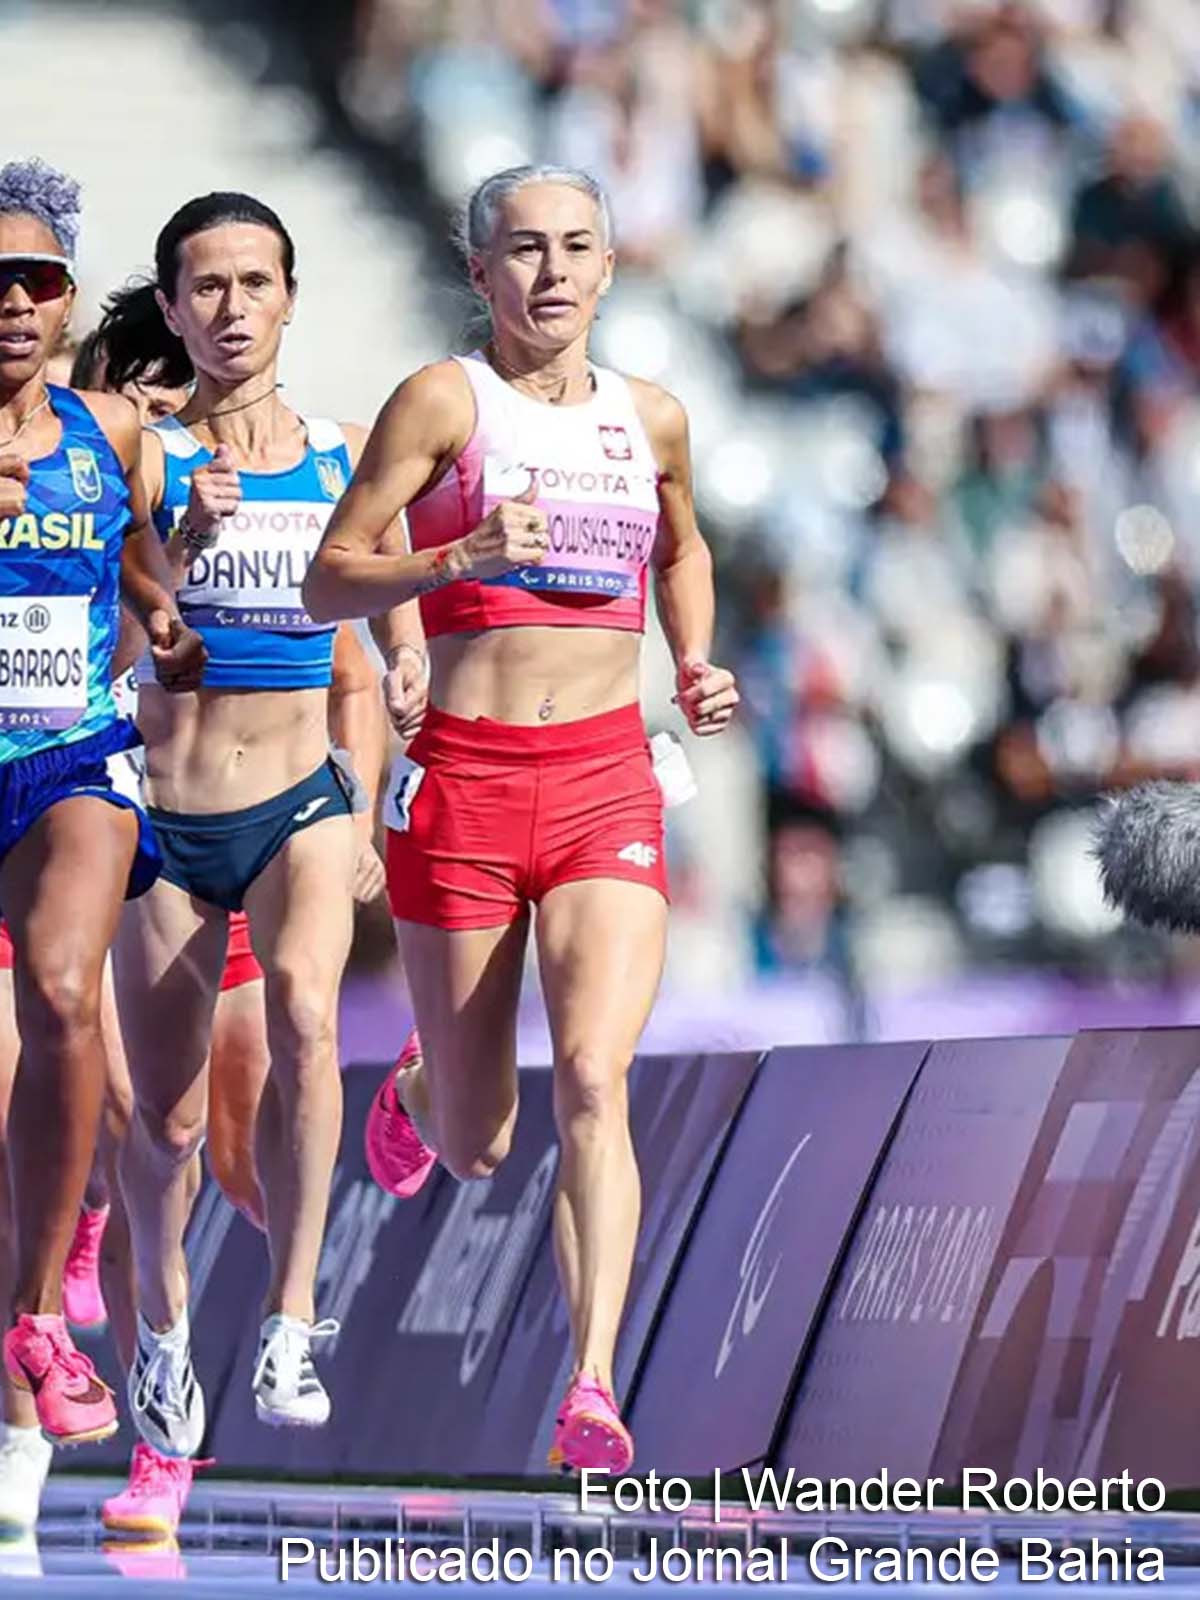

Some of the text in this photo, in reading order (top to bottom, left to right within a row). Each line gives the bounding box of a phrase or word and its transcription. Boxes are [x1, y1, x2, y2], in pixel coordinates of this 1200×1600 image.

[524, 467, 630, 495] TOYOTA
[187, 550, 311, 589] DANYL
[546, 572, 595, 586] PARIS
[241, 613, 287, 625] PARIS
[9, 711, 51, 725] 2024
